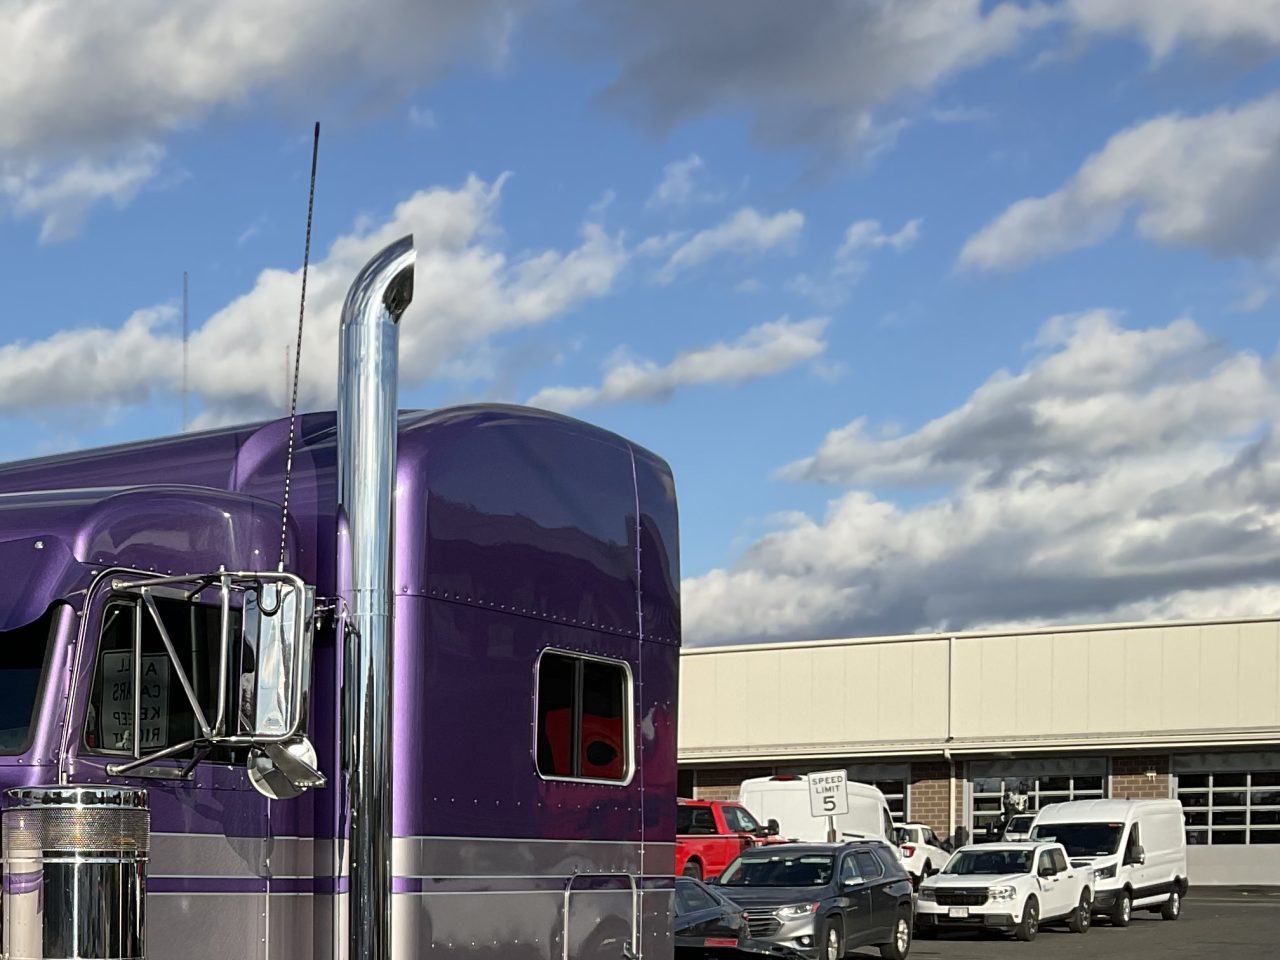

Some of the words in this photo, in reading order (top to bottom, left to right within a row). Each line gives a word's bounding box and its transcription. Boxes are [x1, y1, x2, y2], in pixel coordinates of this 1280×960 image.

[811, 775, 844, 786] SPEED
[815, 785, 841, 794] LIMIT
[822, 795, 837, 812] 5
